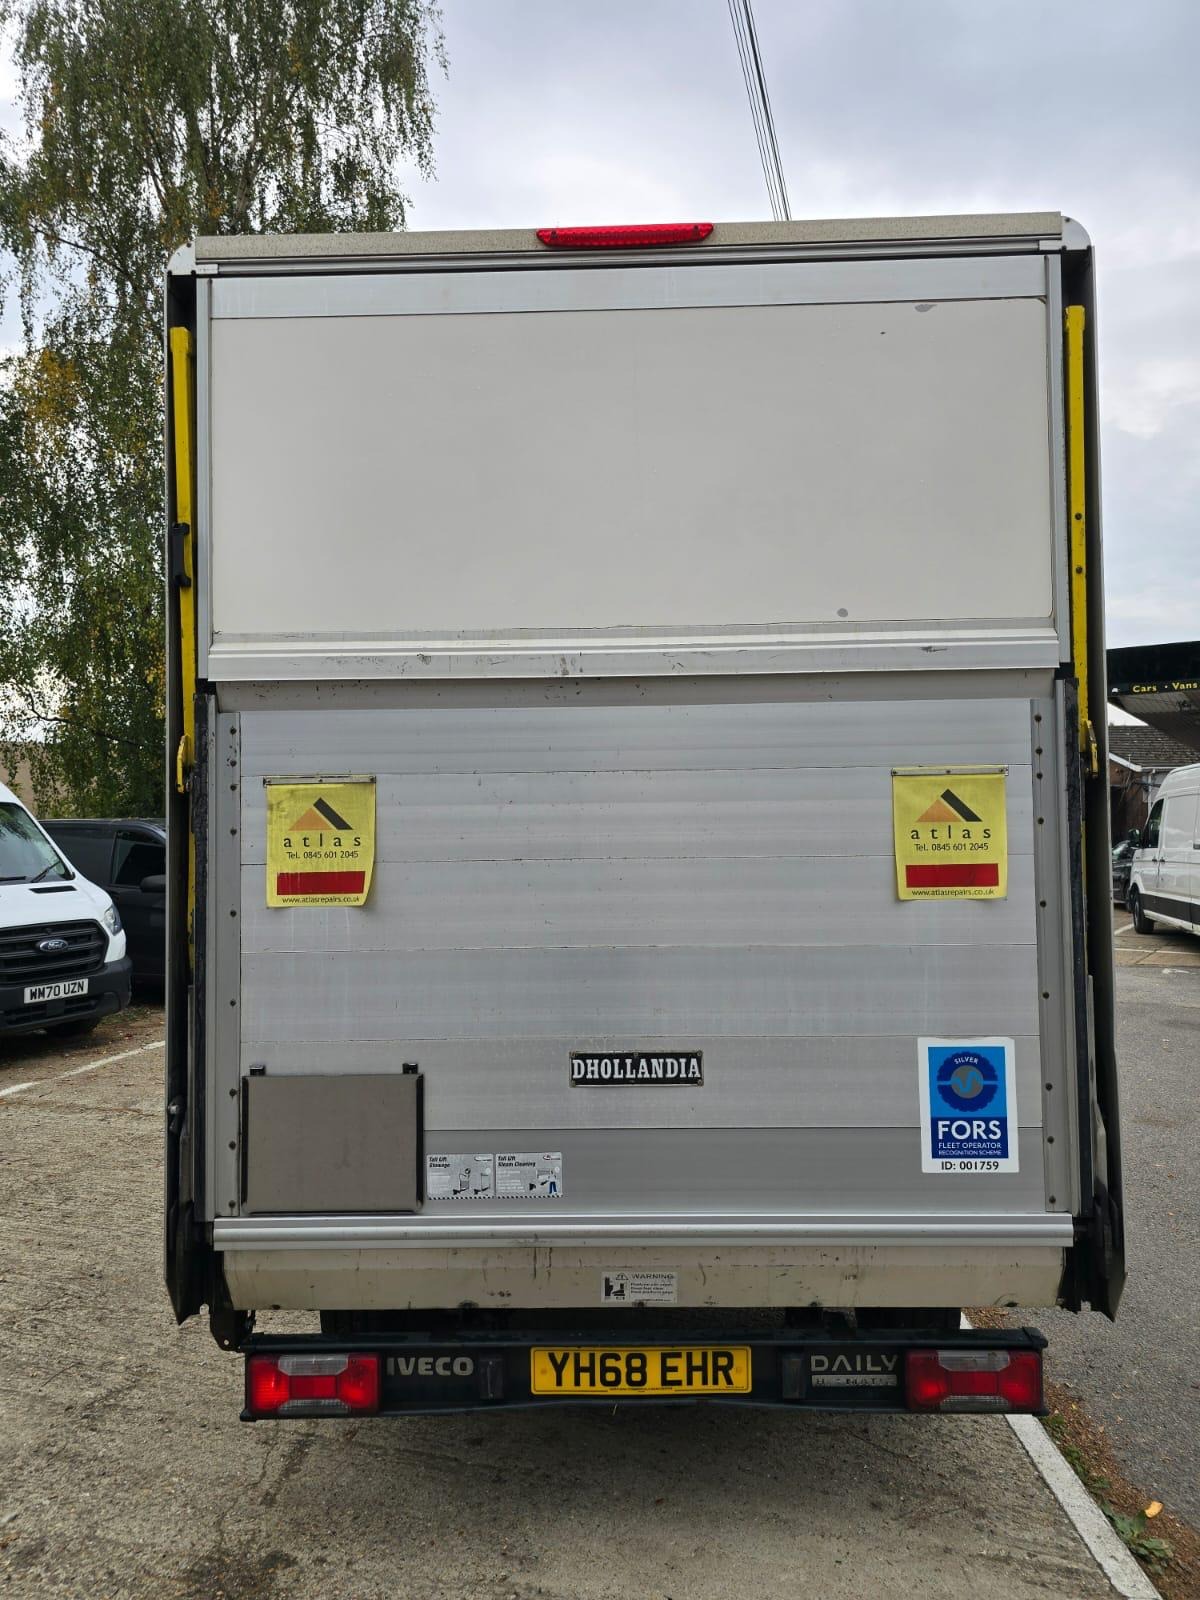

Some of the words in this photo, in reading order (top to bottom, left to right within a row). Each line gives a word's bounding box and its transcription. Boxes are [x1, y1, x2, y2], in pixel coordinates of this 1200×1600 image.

[1132, 684, 1157, 693] Cars
[1171, 681, 1198, 690] Vans
[910, 825, 992, 840] atlas
[283, 833, 361, 848] atlas
[914, 843, 929, 852] Tel.
[931, 843, 951, 852] 0845
[953, 843, 967, 852] 601
[969, 842, 989, 851] 2045
[286, 851, 301, 860] Tel.
[303, 850, 322, 859] 0845
[324, 850, 337, 859] 601
[340, 850, 359, 859] 2045
[281, 895, 360, 904] www.atlasrepairs.co.uk
[911, 888, 995, 897] www.atlasrepairs.co.uk
[29, 985, 61, 1001] WM70
[63, 981, 85, 995] UZN
[954, 1056, 979, 1065] SILVER
[572, 1058, 701, 1079] DHOLLANDIA
[938, 1120, 1002, 1140] FORS
[941, 1160, 956, 1171] ID:
[959, 1160, 999, 1171] 001759
[386, 1356, 475, 1376] IVECO
[548, 1352, 648, 1388] YH68
[660, 1351, 735, 1387] EHR
[811, 1354, 898, 1371] DAILY
